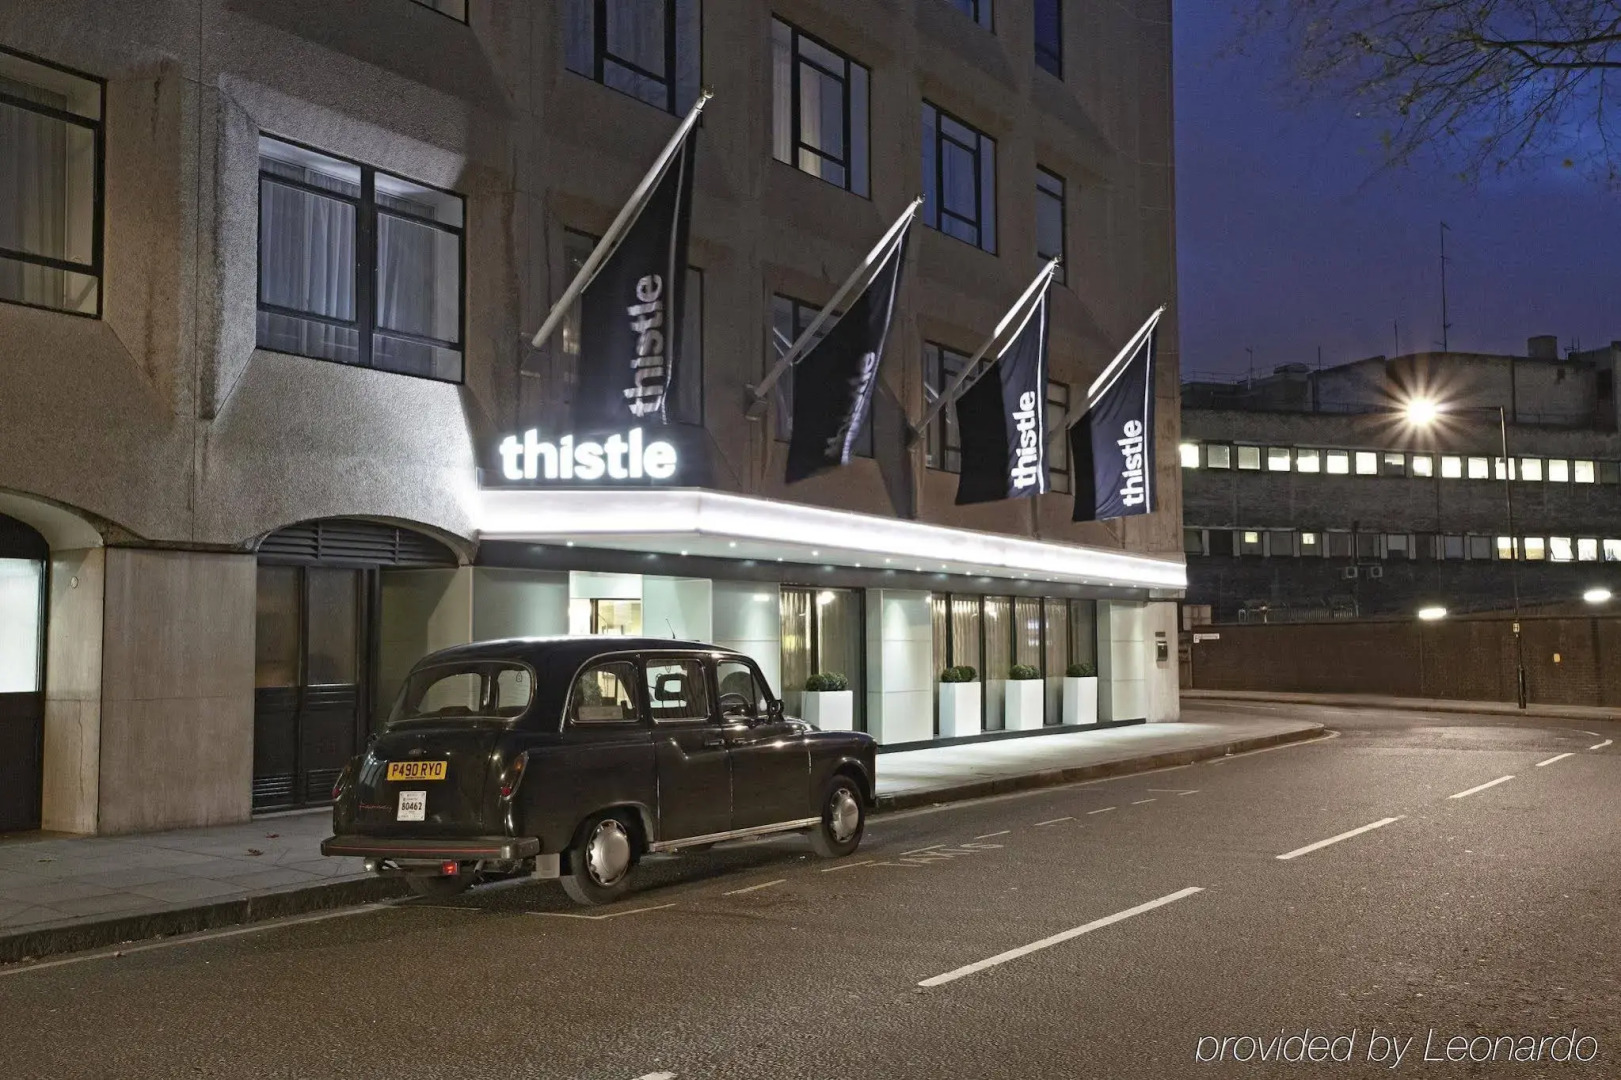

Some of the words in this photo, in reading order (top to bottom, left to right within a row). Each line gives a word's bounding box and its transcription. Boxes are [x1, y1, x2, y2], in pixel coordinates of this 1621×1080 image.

[623, 273, 665, 418] thistle
[499, 426, 678, 481] thistle
[1010, 390, 1038, 489] thistle
[1117, 419, 1145, 507] thistle
[392, 764, 419, 777] P490
[421, 763, 442, 776] RYO
[401, 802, 423, 811] 80462
